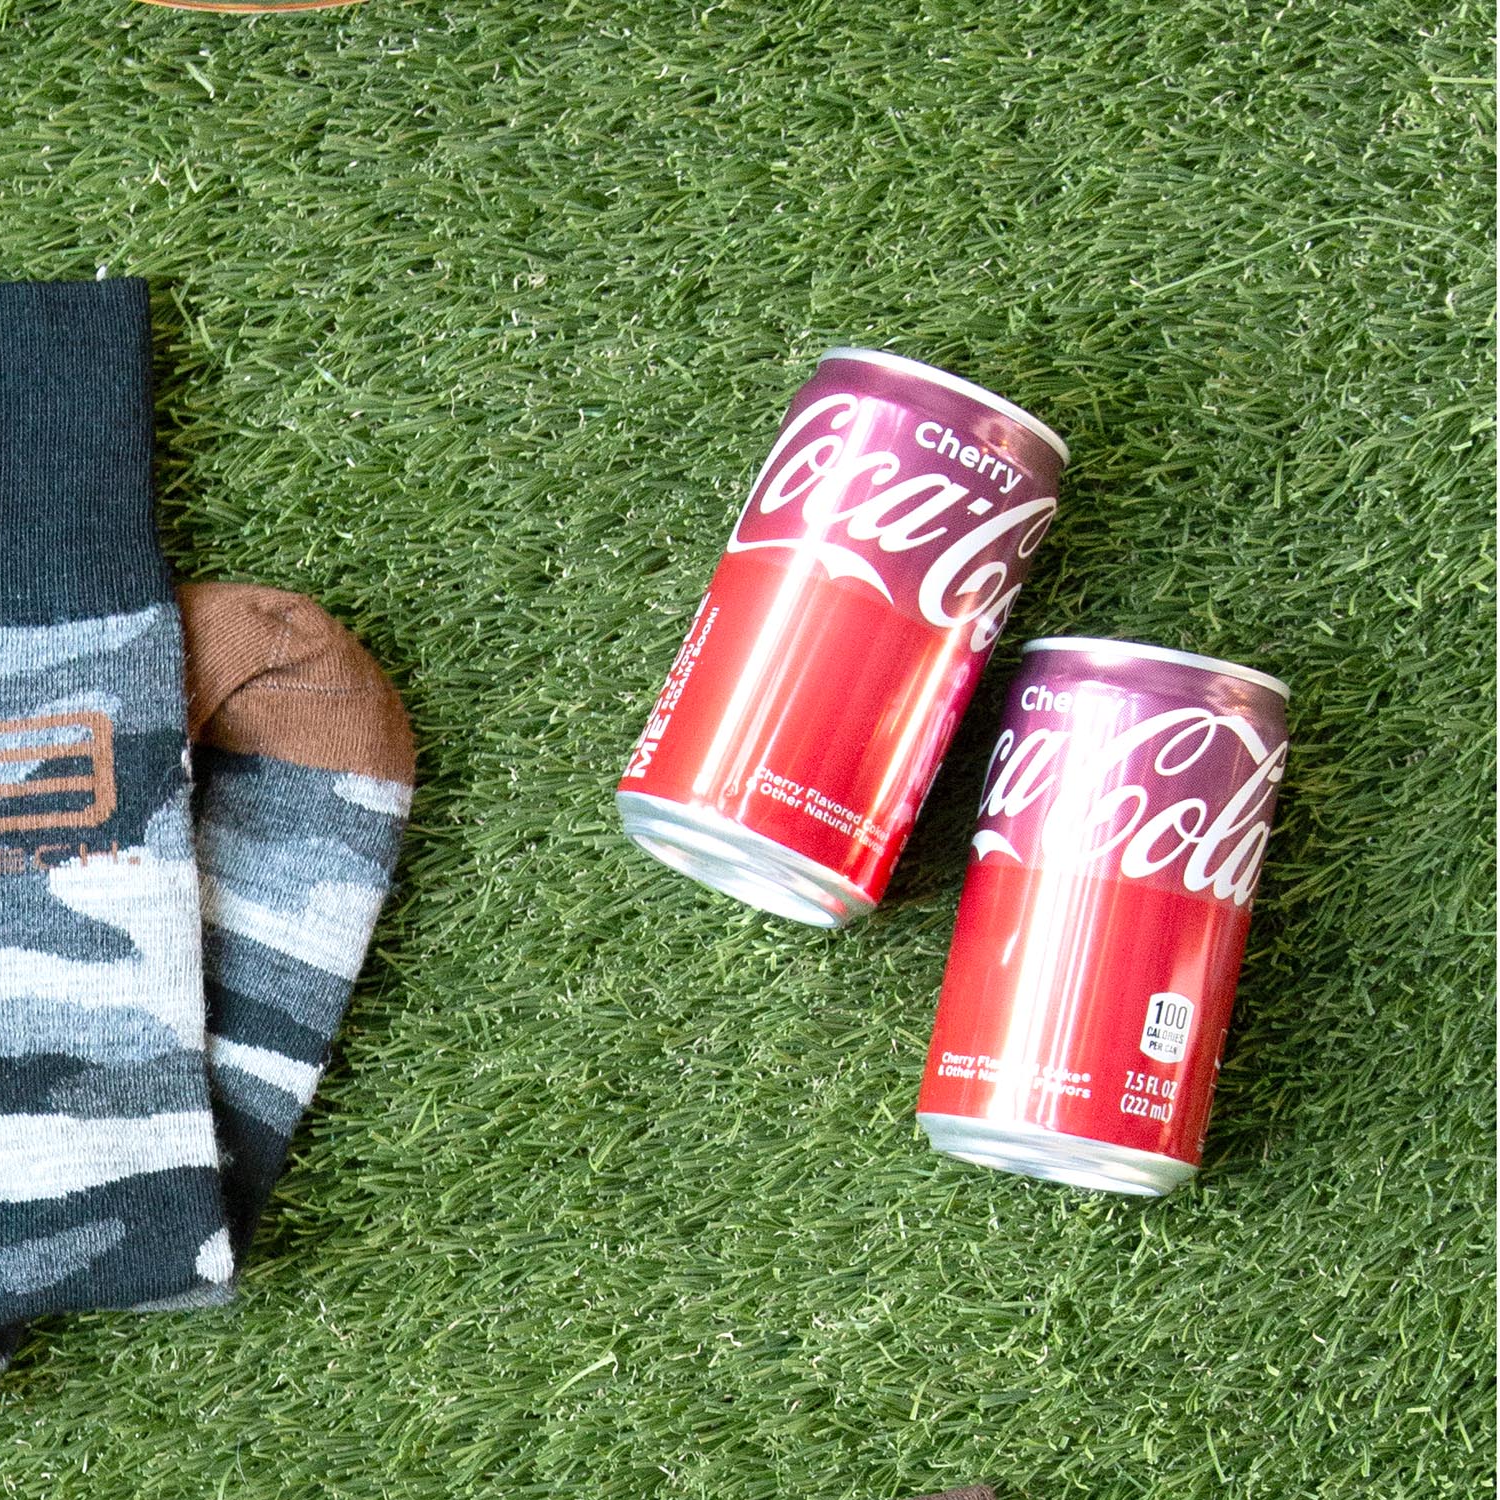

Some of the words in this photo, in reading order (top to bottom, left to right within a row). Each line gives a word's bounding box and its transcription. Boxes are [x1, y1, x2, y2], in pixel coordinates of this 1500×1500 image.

[915, 421, 1023, 493] Cherry
[727, 393, 1057, 653] Coca-Co
[676, 642, 694, 676] YOU
[669, 661, 694, 711] AGAIN
[630, 714, 671, 778] ME
[756, 766, 804, 794] Cherry
[806, 788, 863, 825] Flavored
[760, 782, 802, 808] Other
[804, 804, 851, 836] Natural
[1155, 1000, 1188, 1030] 100
[1146, 1026, 1184, 1044] CALORIES
[1148, 1040, 1162, 1051] PER
[941, 1052, 975, 1068] Cherry
[945, 1065, 976, 1080] Other
[1124, 1070, 1145, 1092] 7.5
[1145, 1075, 1159, 1096] FL
[1161, 1080, 1178, 1101] OZ
[1120, 1093, 1149, 1117] (222
[1150, 1103, 1173, 1124] mL)
